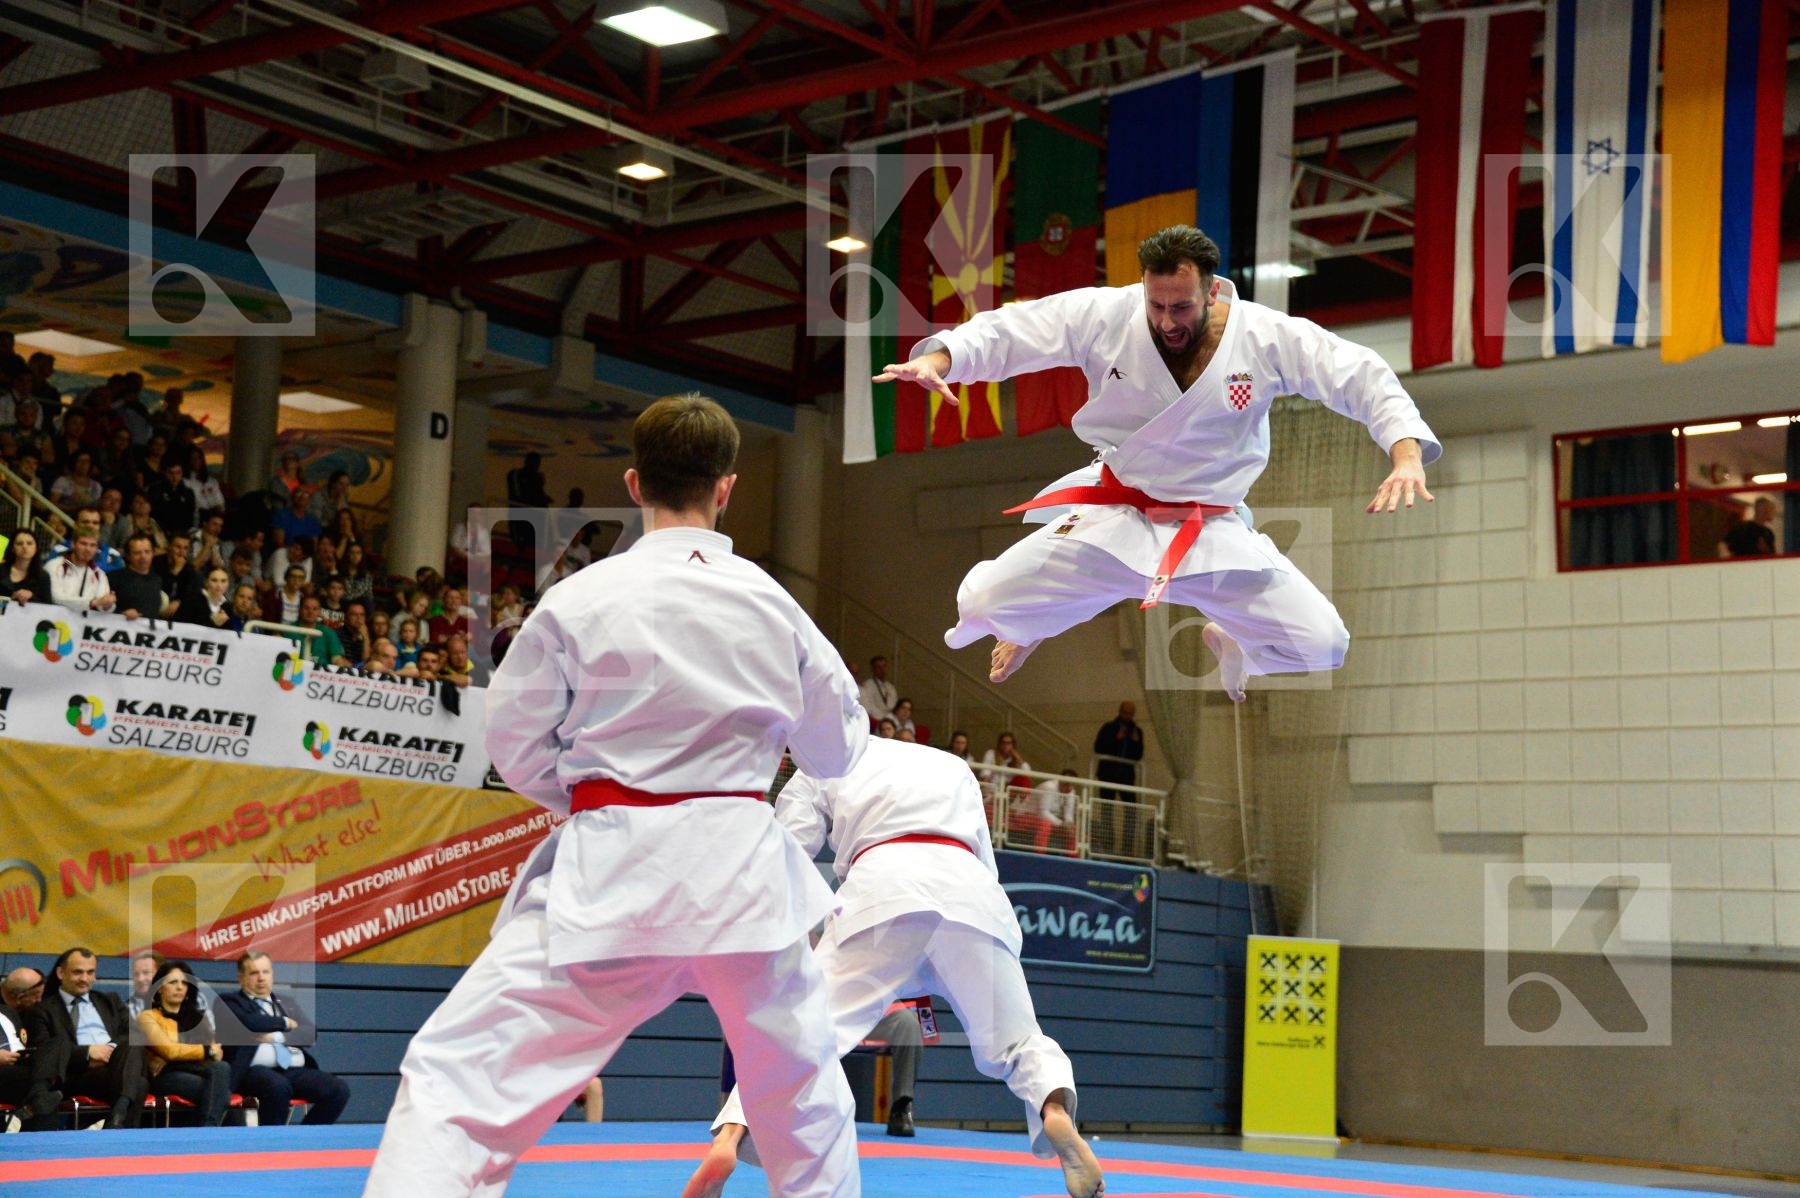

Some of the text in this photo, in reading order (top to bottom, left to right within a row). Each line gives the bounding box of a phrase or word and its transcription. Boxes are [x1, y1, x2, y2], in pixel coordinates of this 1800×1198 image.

[430, 411, 449, 440] D
[82, 625, 228, 666] KARATE1
[74, 651, 223, 687] SALZBURG
[115, 698, 257, 737] KARATE1
[306, 681, 435, 717] SALZBURG
[108, 724, 250, 758] SALZBURG
[338, 726, 466, 764] KARATE1
[332, 750, 457, 783] SALZBURG
[251, 797, 381, 883] What else!
[200, 924, 241, 953] IHRE
[240, 863, 407, 937] EINKAUFSPLATTFORM
[407, 853, 435, 877] MIT
[435, 840, 472, 866] ÜBER
